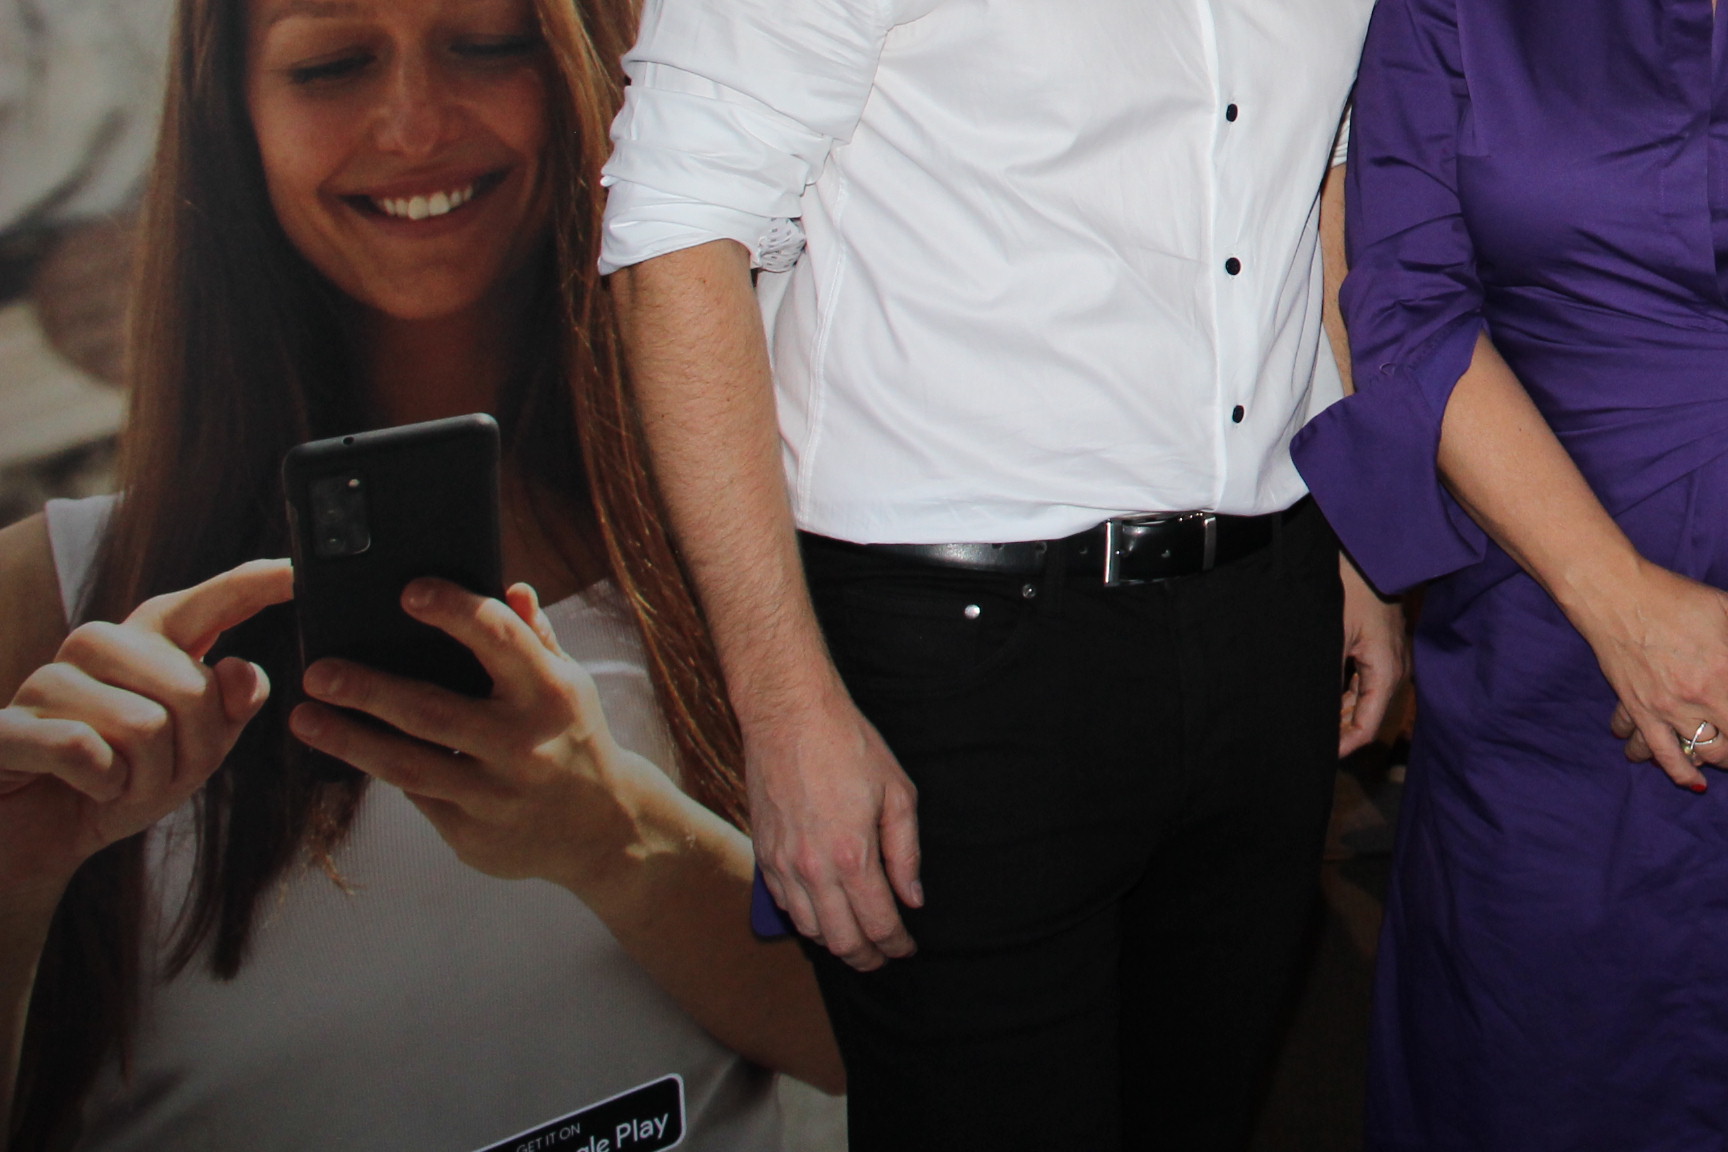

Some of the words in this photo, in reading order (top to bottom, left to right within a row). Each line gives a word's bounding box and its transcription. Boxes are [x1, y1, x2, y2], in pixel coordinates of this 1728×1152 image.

[545, 1132, 555, 1146] IT
[559, 1123, 581, 1140] ON
[616, 1113, 668, 1148] Play
